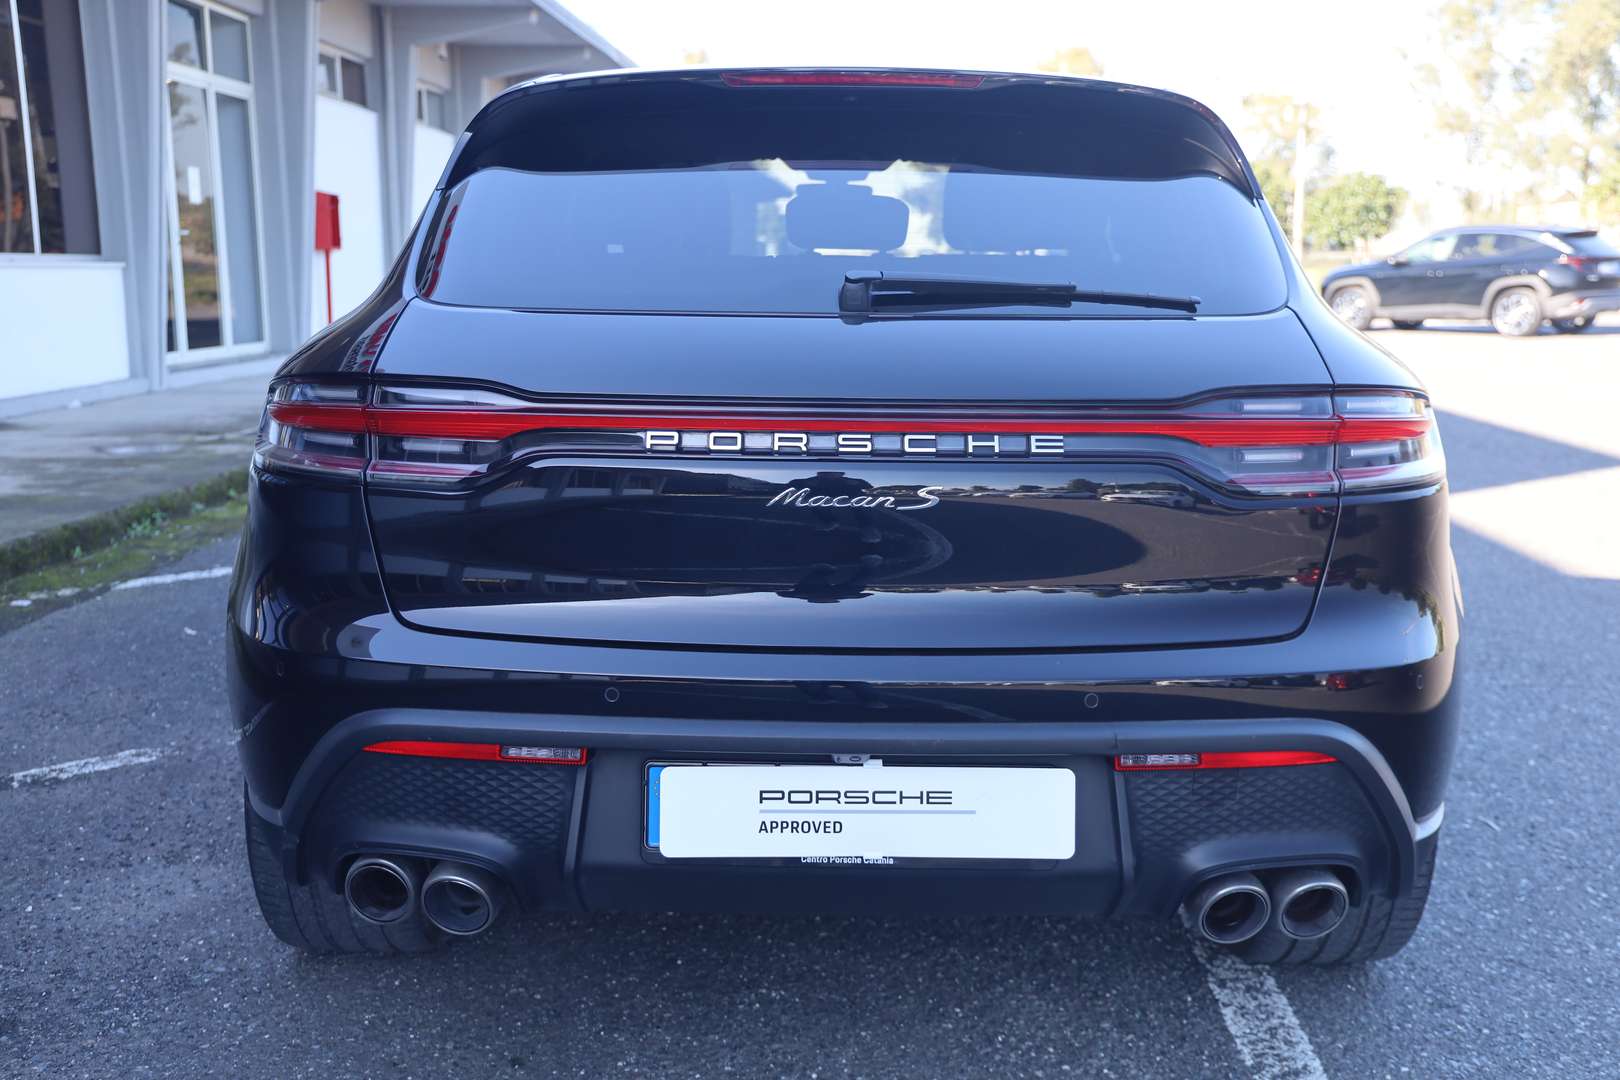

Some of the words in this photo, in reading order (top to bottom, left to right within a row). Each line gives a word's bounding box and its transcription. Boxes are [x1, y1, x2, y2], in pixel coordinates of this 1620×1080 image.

[645, 430, 1065, 454] PORSCHE
[765, 487, 895, 508] Macan
[896, 486, 943, 511] S
[758, 789, 953, 806] PORSCHE
[758, 820, 844, 835] APPROVED
[829, 856, 862, 864] Porsche
